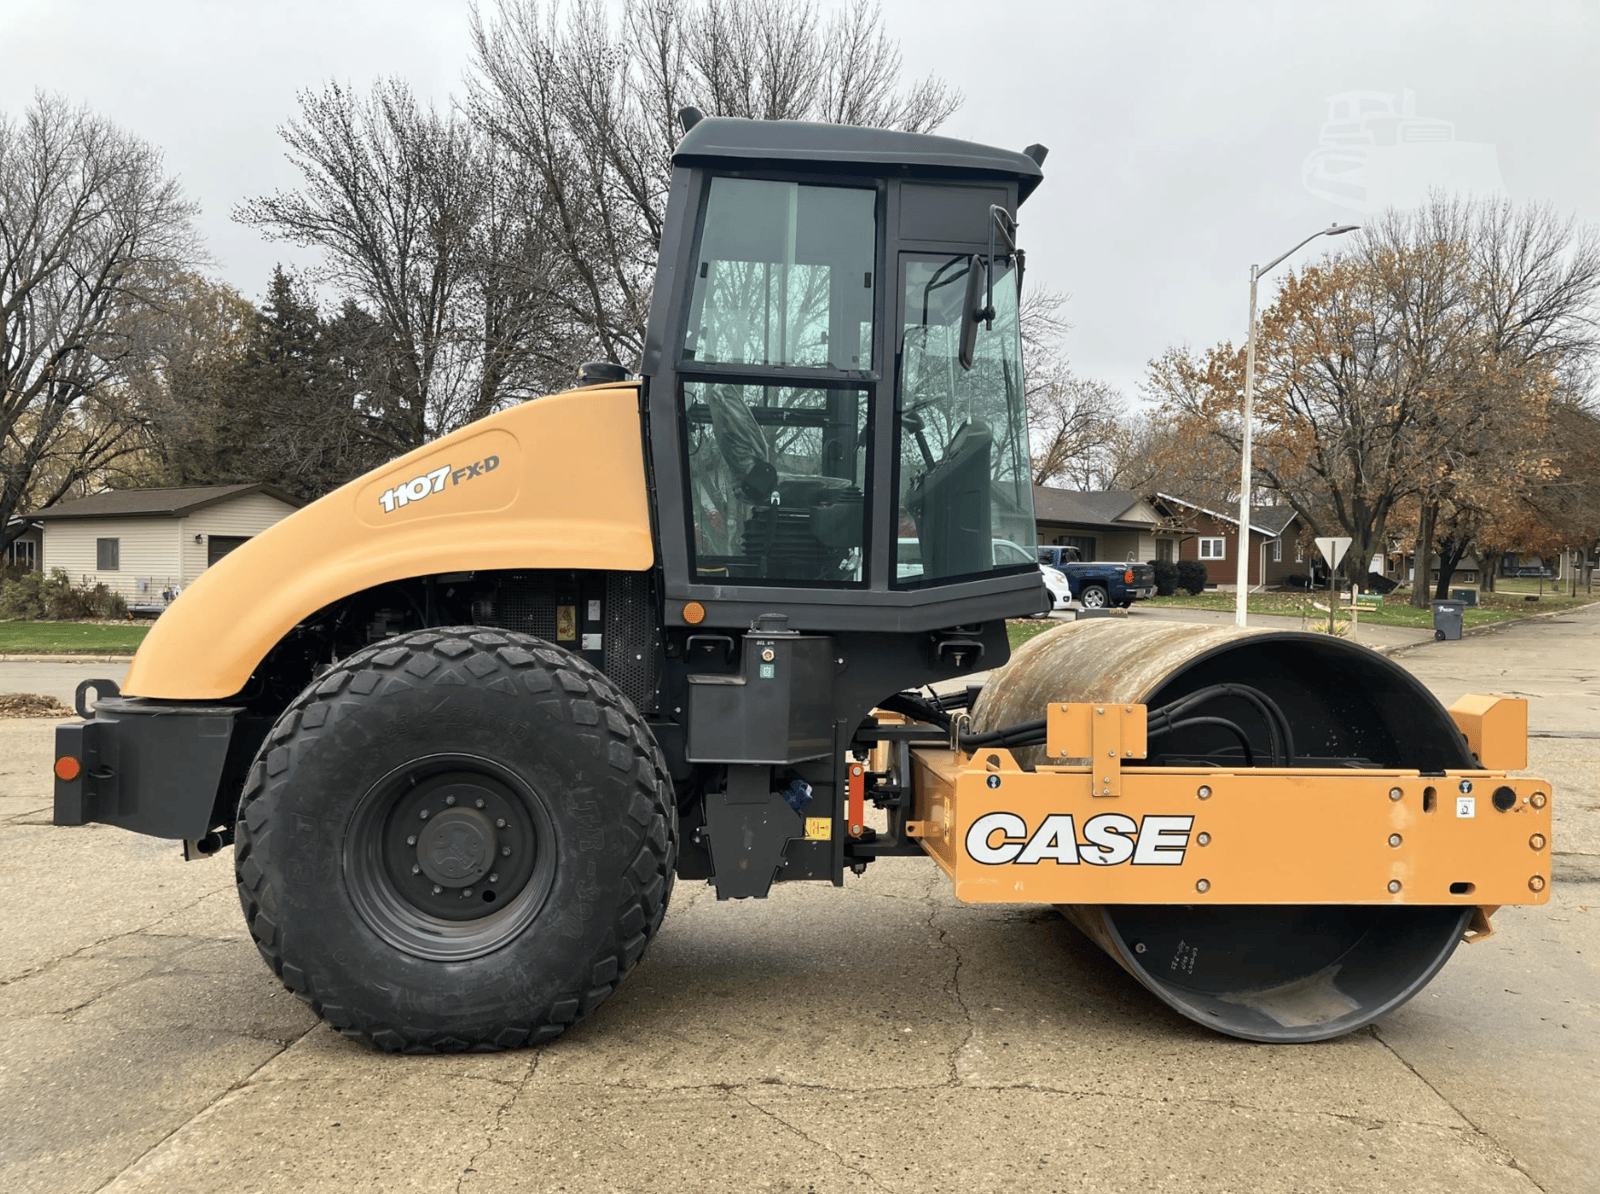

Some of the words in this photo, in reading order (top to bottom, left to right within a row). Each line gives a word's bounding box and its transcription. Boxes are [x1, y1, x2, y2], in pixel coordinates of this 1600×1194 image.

[378, 464, 451, 514] 1107
[451, 455, 500, 486] FX-D
[965, 811, 1195, 866] CASE
